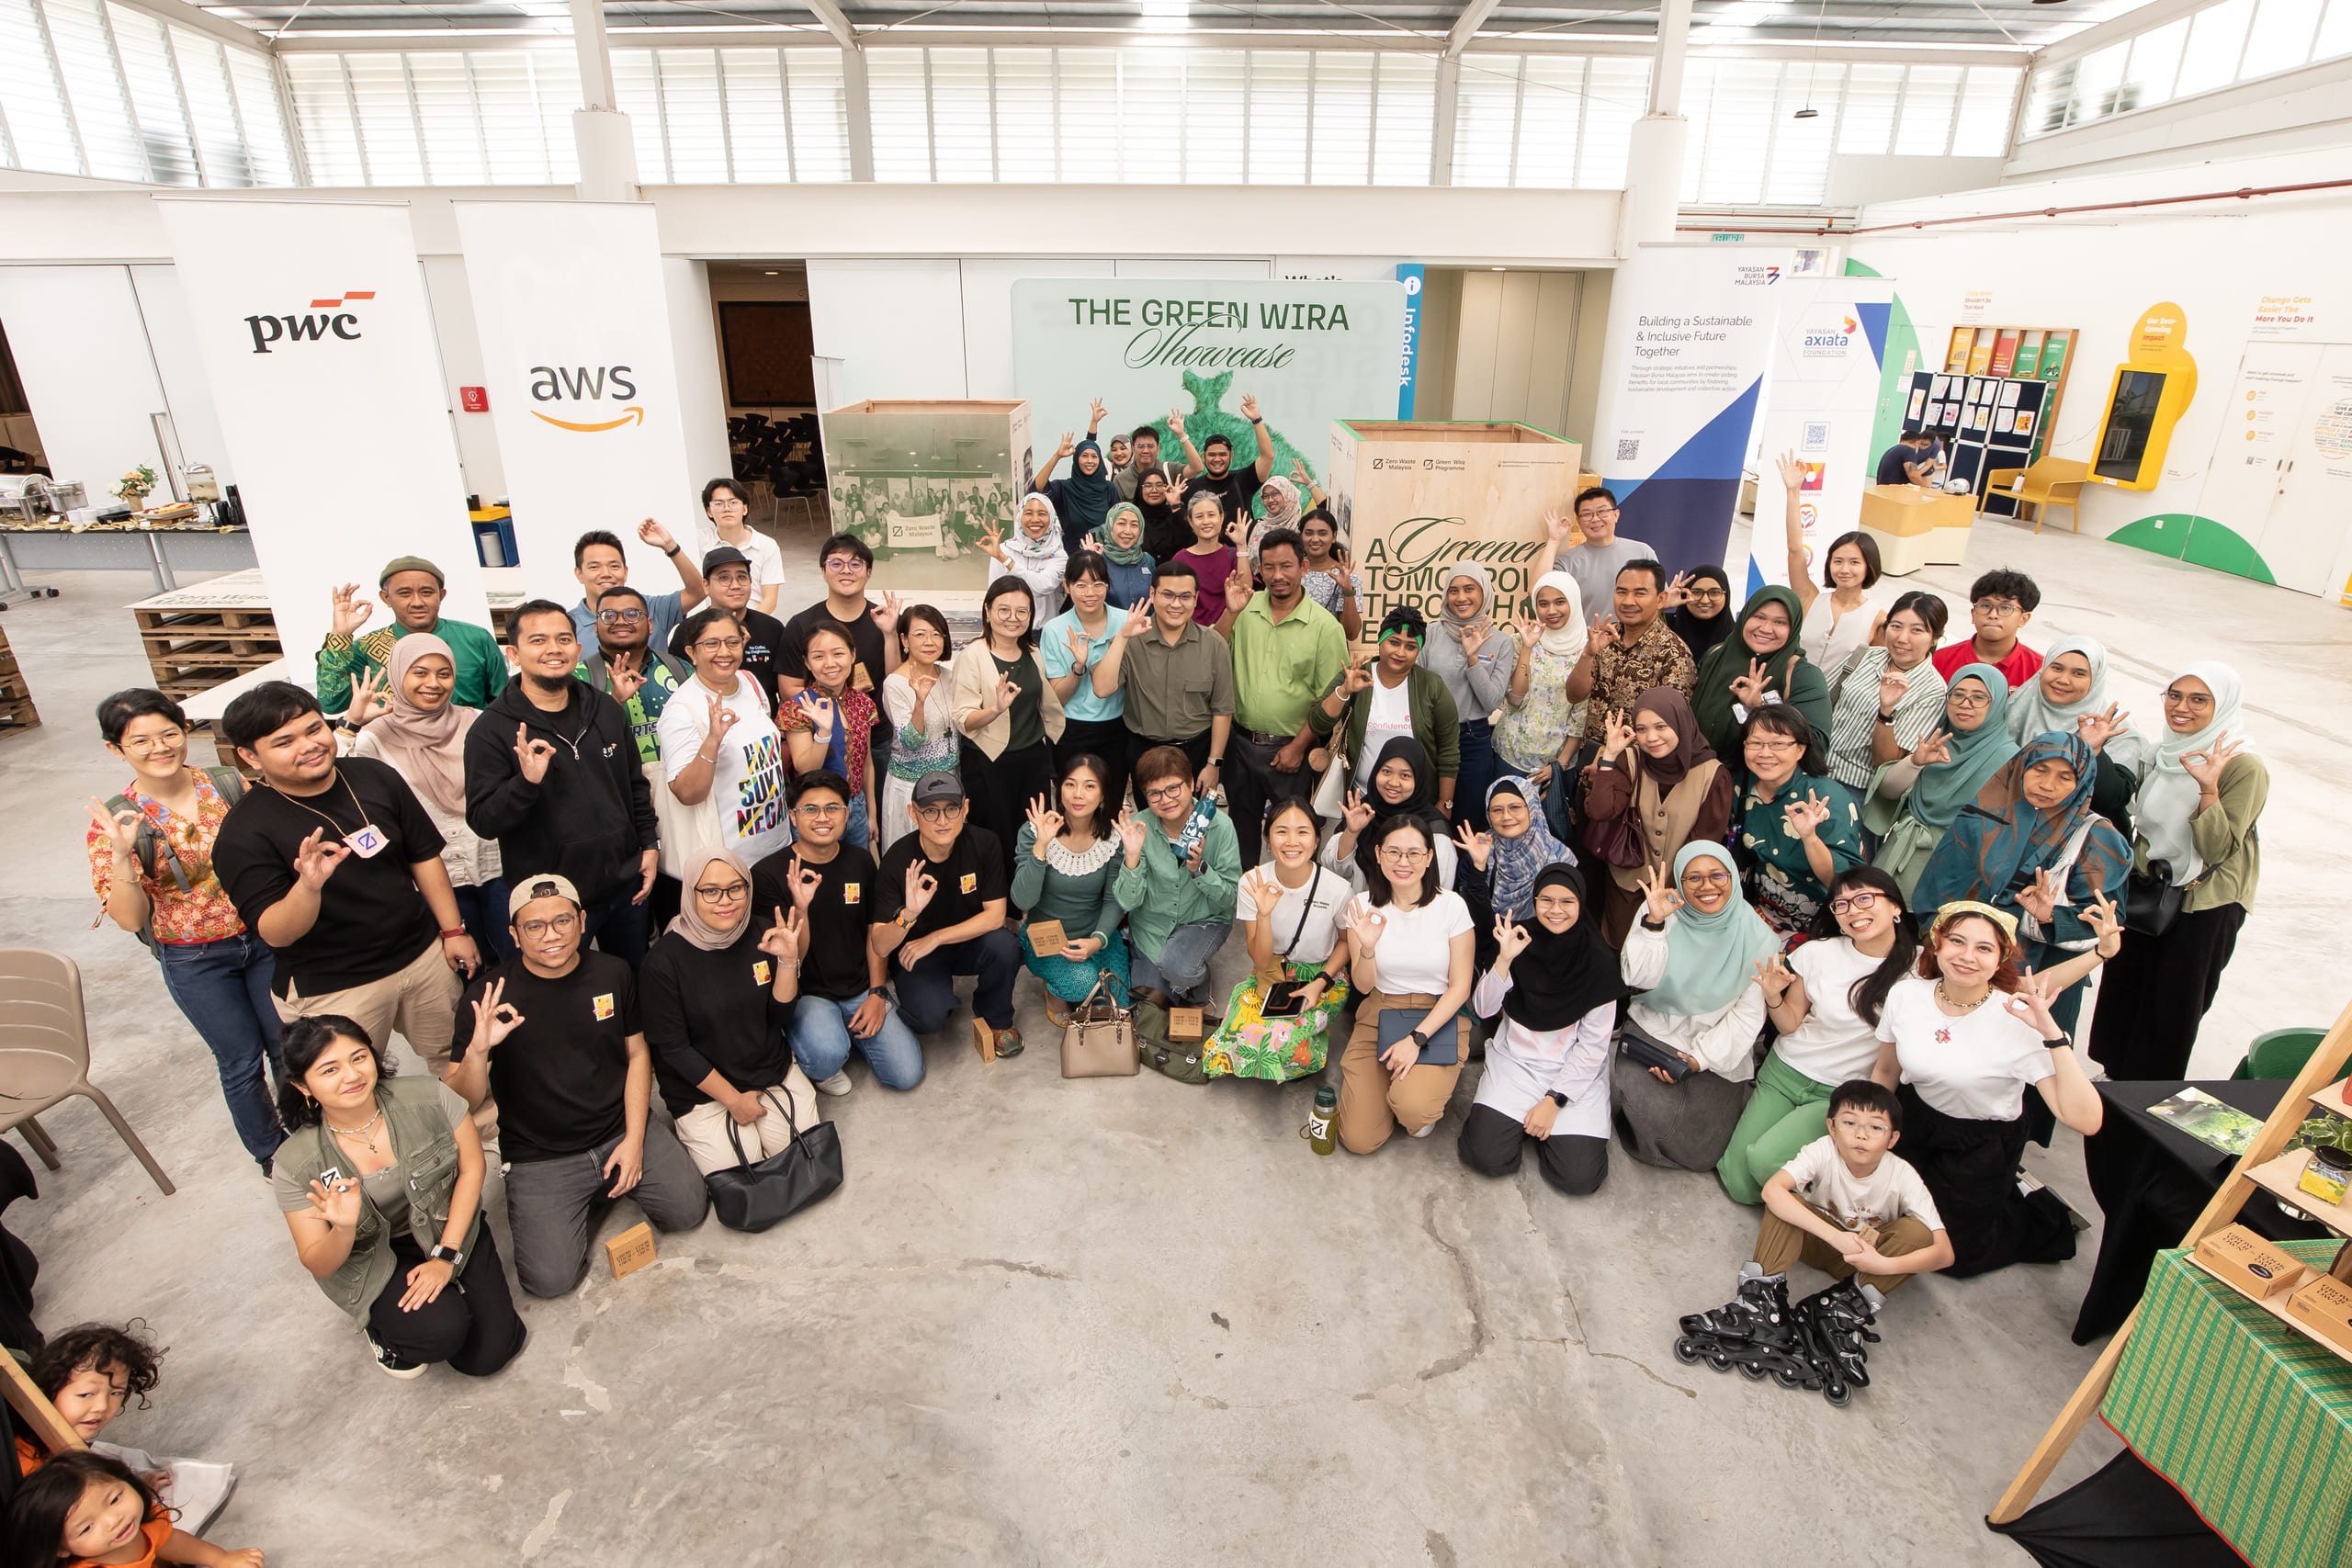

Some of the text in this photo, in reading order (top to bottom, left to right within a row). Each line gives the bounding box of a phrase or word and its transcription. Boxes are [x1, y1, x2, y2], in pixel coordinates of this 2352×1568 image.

[2261, 296, 2291, 305] Change
[1068, 299, 1350, 331] THE GREEN WIRA
[1639, 316, 1681, 329] Building
[1692, 316, 1753, 326] Sustainable
[244, 312, 362, 354] pwc
[1124, 313, 1295, 369] Showcase
[1635, 331, 1726, 342] & Inclusive Future
[1804, 333, 1849, 346] axiata
[1399, 309, 1416, 387] Infodesk
[1635, 345, 1680, 358] Together
[529, 366, 637, 401] aws
[1365, 538, 1388, 563] A
[1385, 517, 1547, 577] Greener
[631, 720, 658, 739] RTS
[742, 731, 781, 775] HARI
[2223, 1237, 2242, 1251] OWN
[2226, 1235, 2249, 1251] YOUR
[2229, 1232, 2253, 1248] GROW
[2261, 1253, 2286, 1269] COOK
[2317, 1291, 2340, 1305] OWN
[2321, 1287, 2346, 1304] YOUR
[2323, 1284, 2348, 1302] GROW
